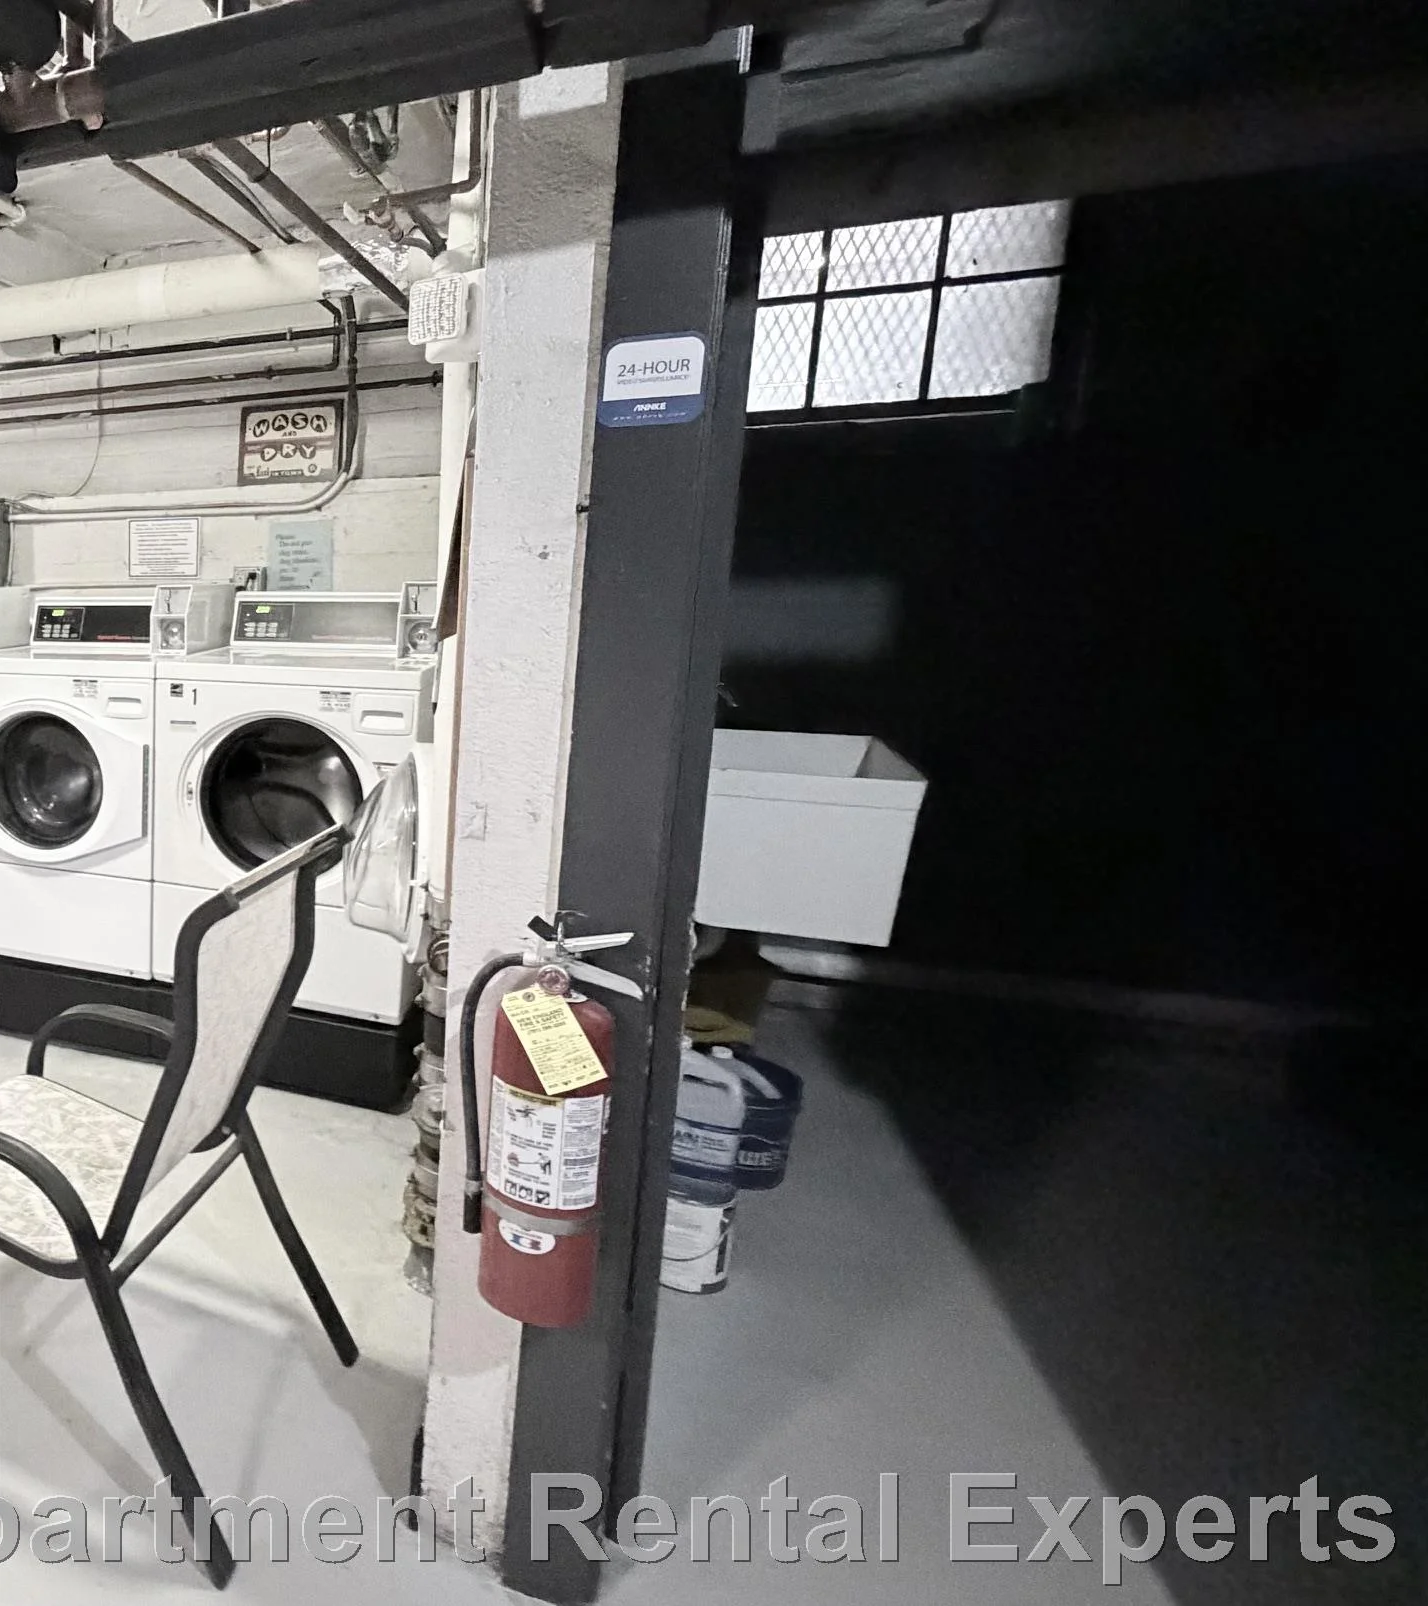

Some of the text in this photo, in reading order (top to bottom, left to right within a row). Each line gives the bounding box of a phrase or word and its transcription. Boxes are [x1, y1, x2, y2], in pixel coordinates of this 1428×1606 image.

[618, 359, 690, 377] 24-HOUR
[253, 413, 327, 437] WASH
[260, 443, 316, 461] DRY
[191, 687, 197, 706] 1
